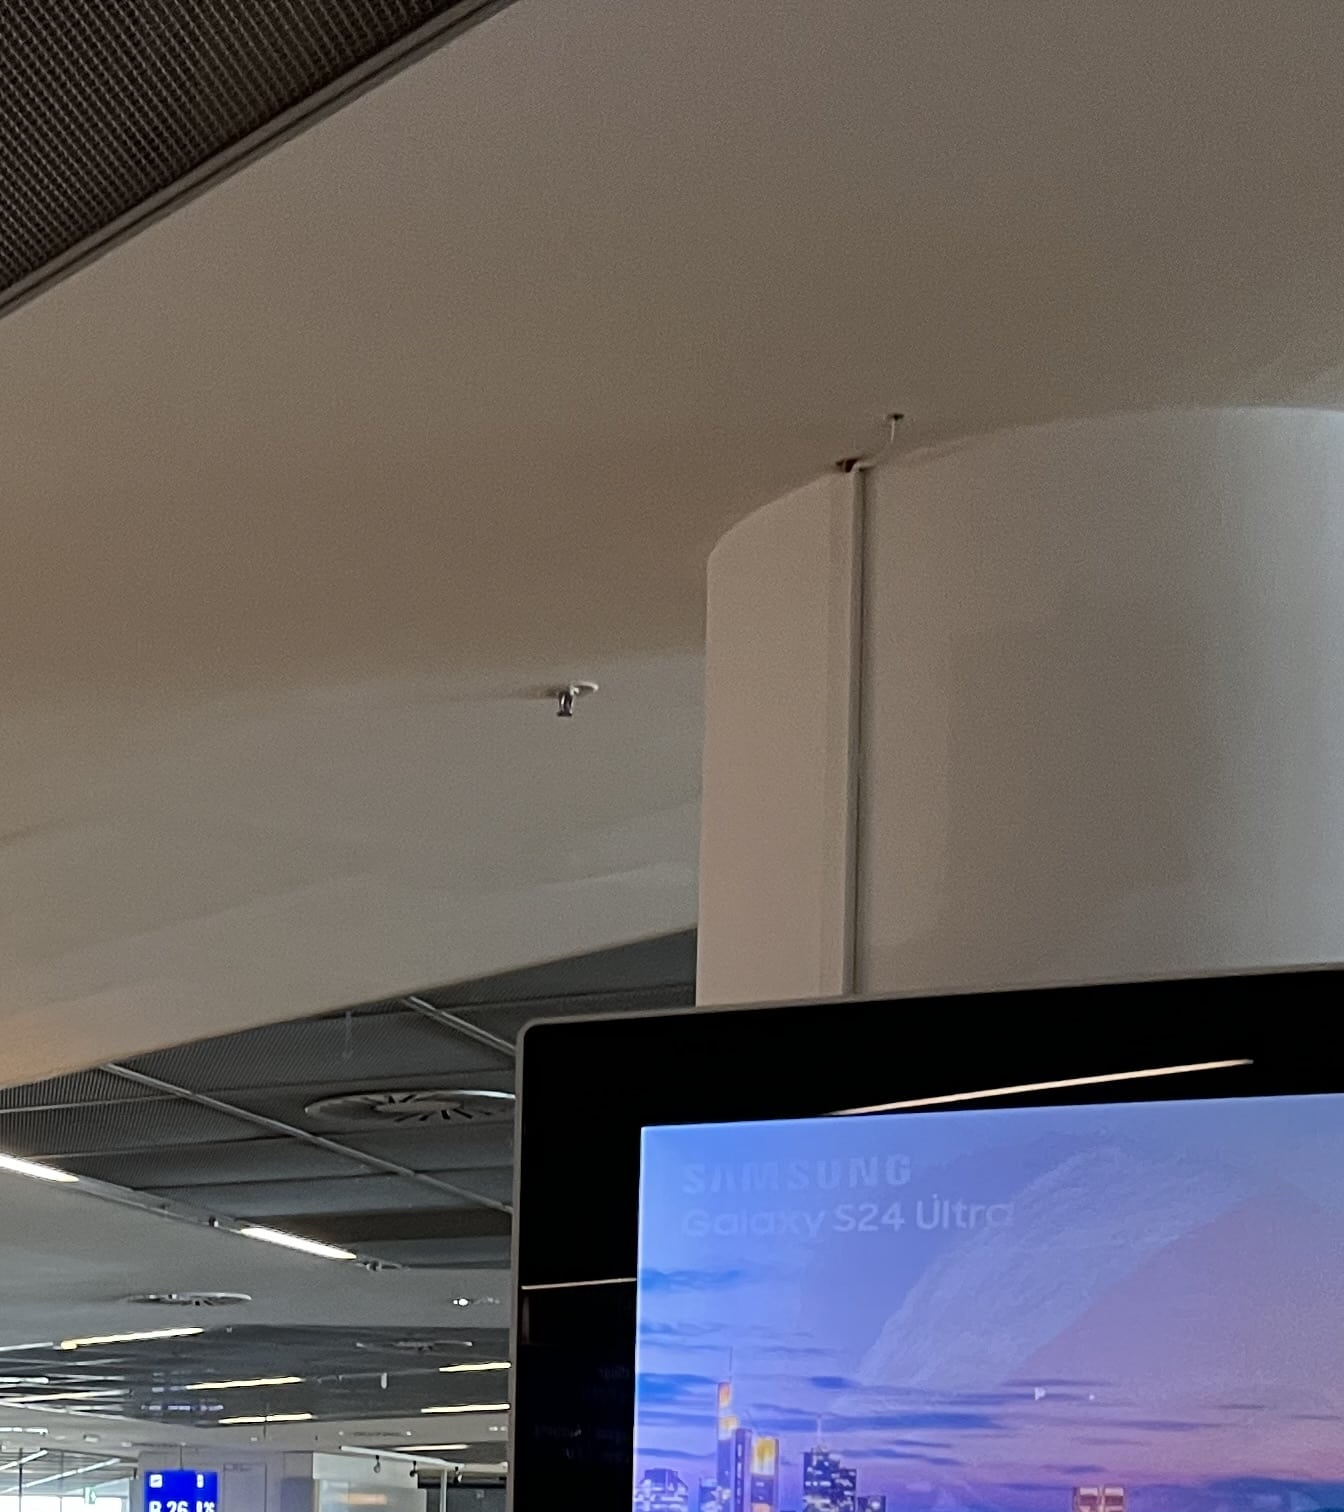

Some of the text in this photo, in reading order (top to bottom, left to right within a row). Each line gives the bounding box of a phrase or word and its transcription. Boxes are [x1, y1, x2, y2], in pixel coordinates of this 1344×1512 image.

[681, 1153, 912, 1196] SAMSUNG
[680, 1197, 1015, 1240] Galaxy S24 Ultra
